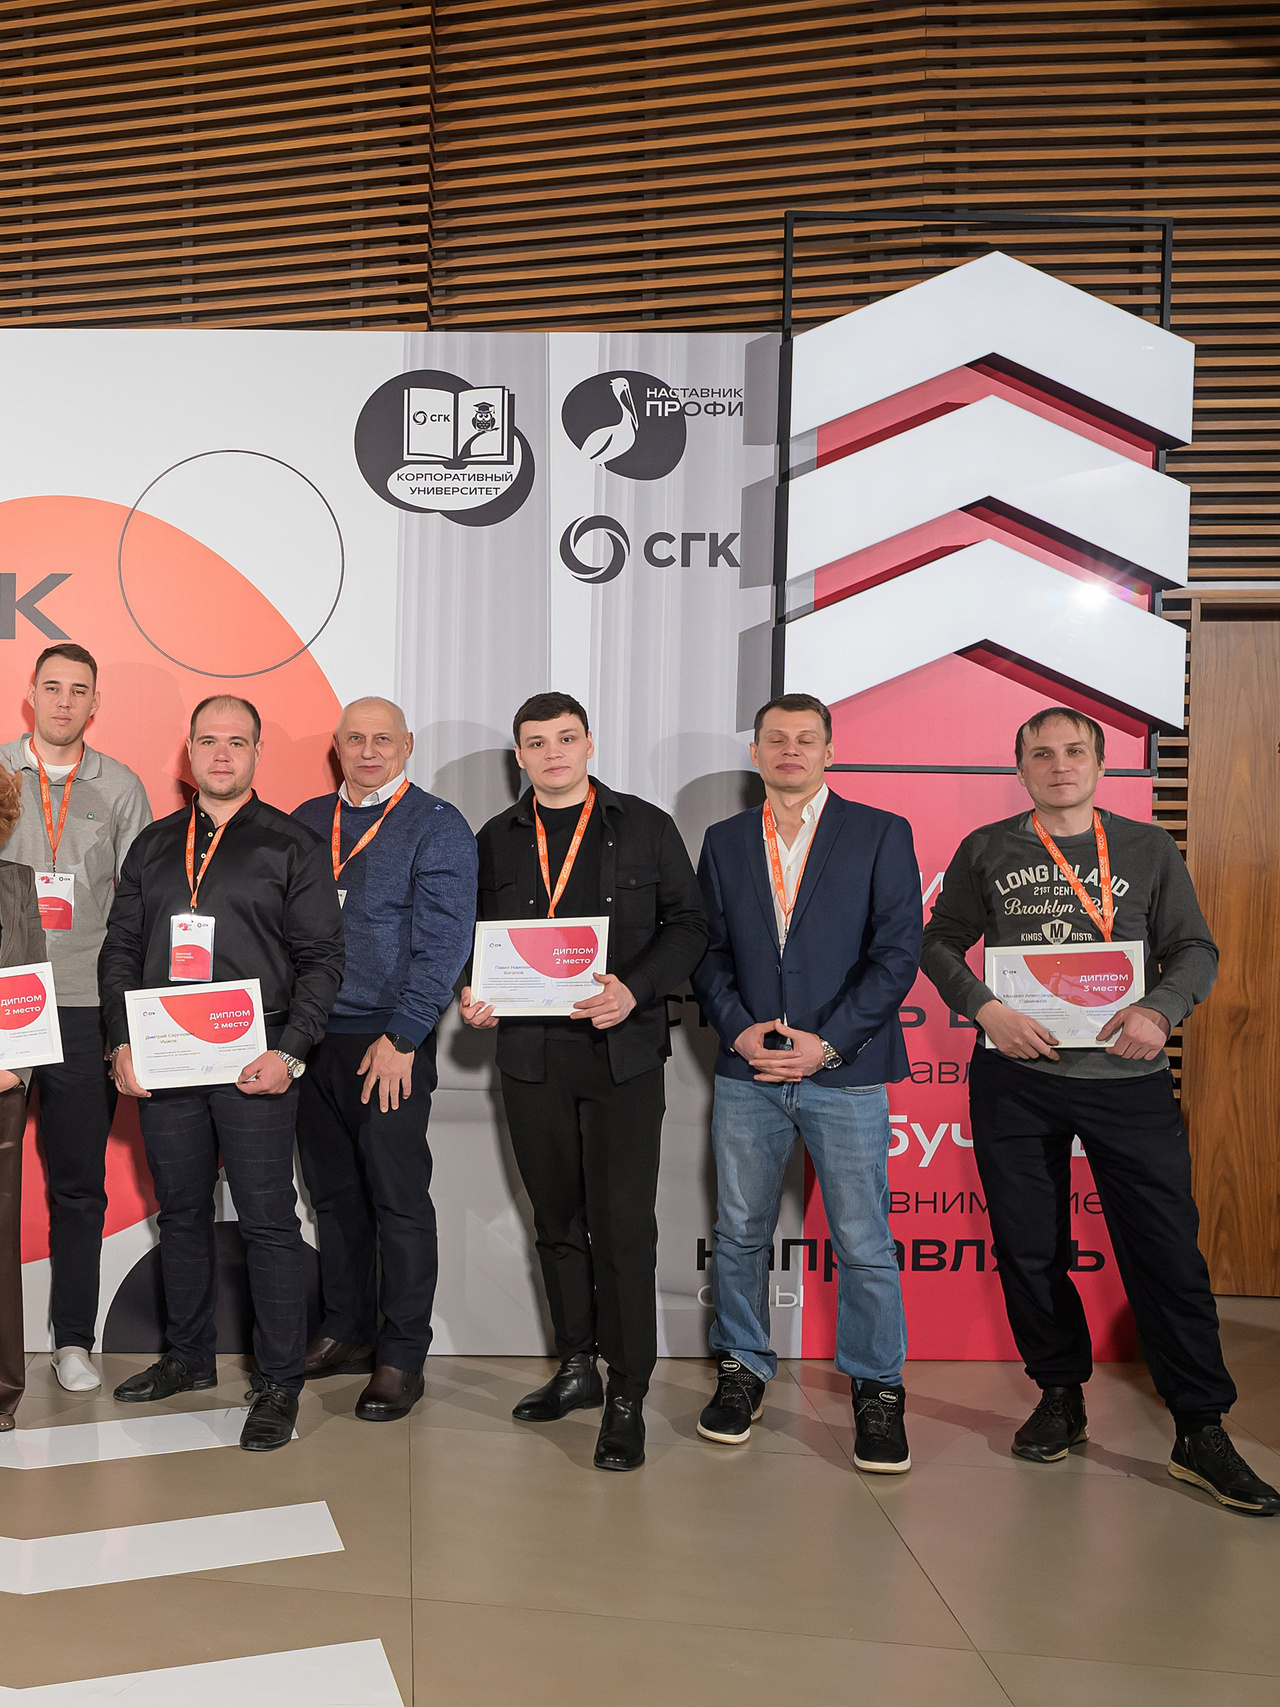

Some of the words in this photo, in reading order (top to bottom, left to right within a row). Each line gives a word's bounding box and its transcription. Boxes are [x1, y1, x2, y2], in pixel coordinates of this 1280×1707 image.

[646, 386, 744, 399] НАСТАВНИК
[645, 400, 744, 418] ПРОФИ
[429, 412, 451, 424] СГК
[396, 470, 514, 483] КОРПОРАТИВНЫЙ
[408, 486, 501, 497] УНИВЕРСИТЕТ
[643, 531, 741, 569] СГК
[579, 814, 588, 831] 2026
[562, 861, 572, 879] 2026
[774, 865, 782, 883] 2026
[1047, 842, 1061, 860] 2026
[1062, 862, 1078, 884] ПРОФИ
[1078, 888, 1091, 906] 2026
[995, 864, 1050, 896] LONG
[1033, 886, 1051, 896] 21ST
[1102, 884, 1110, 903] 2026
[1004, 897, 1076, 918] Brooklyn
[1020, 932, 1043, 942] KINGS
[1050, 923, 1064, 938] M
[1071, 932, 1095, 942] DISTR.
[552, 948, 594, 956] ДИПЛОМ
[1079, 974, 1129, 983] ДИПЛОМ
[0, 994, 42, 1007] ДИПЛОМ
[4, 1008, 11, 1016] 2
[12, 1006, 41, 1015] место
[209, 1009, 251, 1021] ДИПЛОМ
[214, 1022, 220, 1030] 2
[221, 1020, 250, 1029] место
